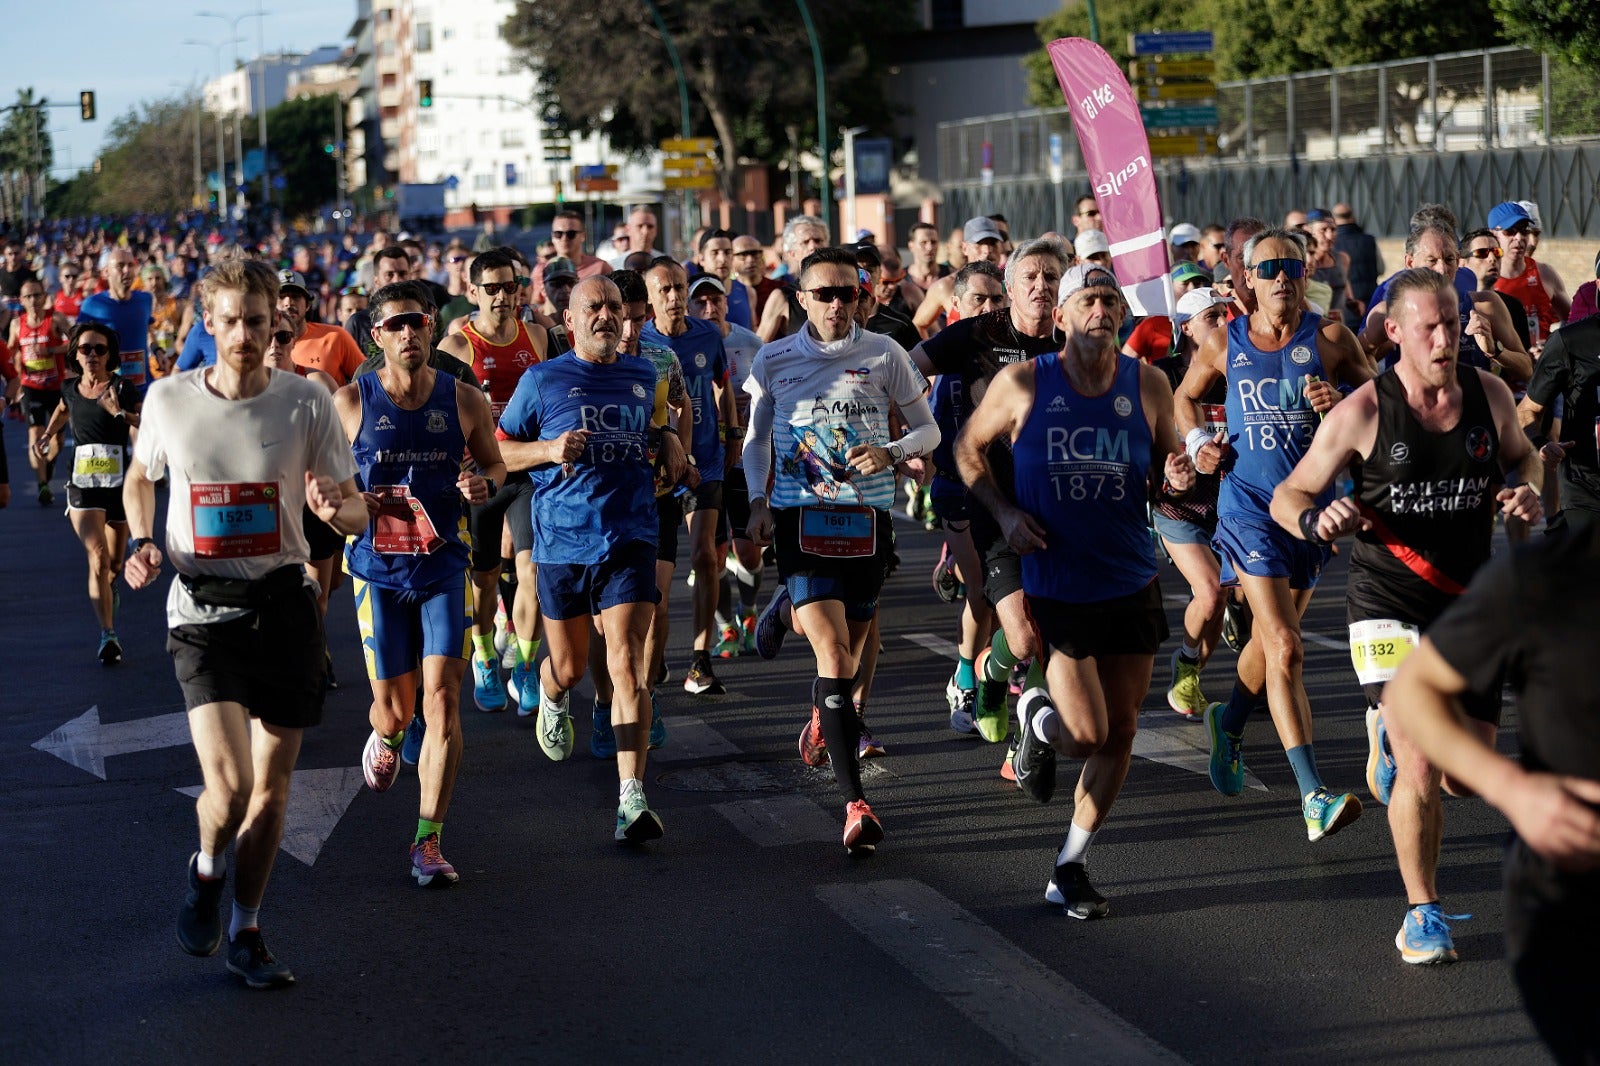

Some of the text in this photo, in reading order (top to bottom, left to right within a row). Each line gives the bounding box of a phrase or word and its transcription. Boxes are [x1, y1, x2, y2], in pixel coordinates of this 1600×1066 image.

[1238, 376, 1311, 411] RCM
[580, 404, 646, 432] RCM
[1205, 426, 1229, 434] AKER
[1244, 424, 1314, 450] 1873
[587, 442, 643, 464] 1873
[1047, 427, 1130, 462] RCM
[1050, 475, 1126, 501] 1873
[1389, 476, 1490, 498] HAILSHAM
[1391, 492, 1483, 513] HARRIERS
[217, 509, 253, 524] 1525
[823, 515, 852, 527] 1601
[1358, 643, 1395, 658] 11332
